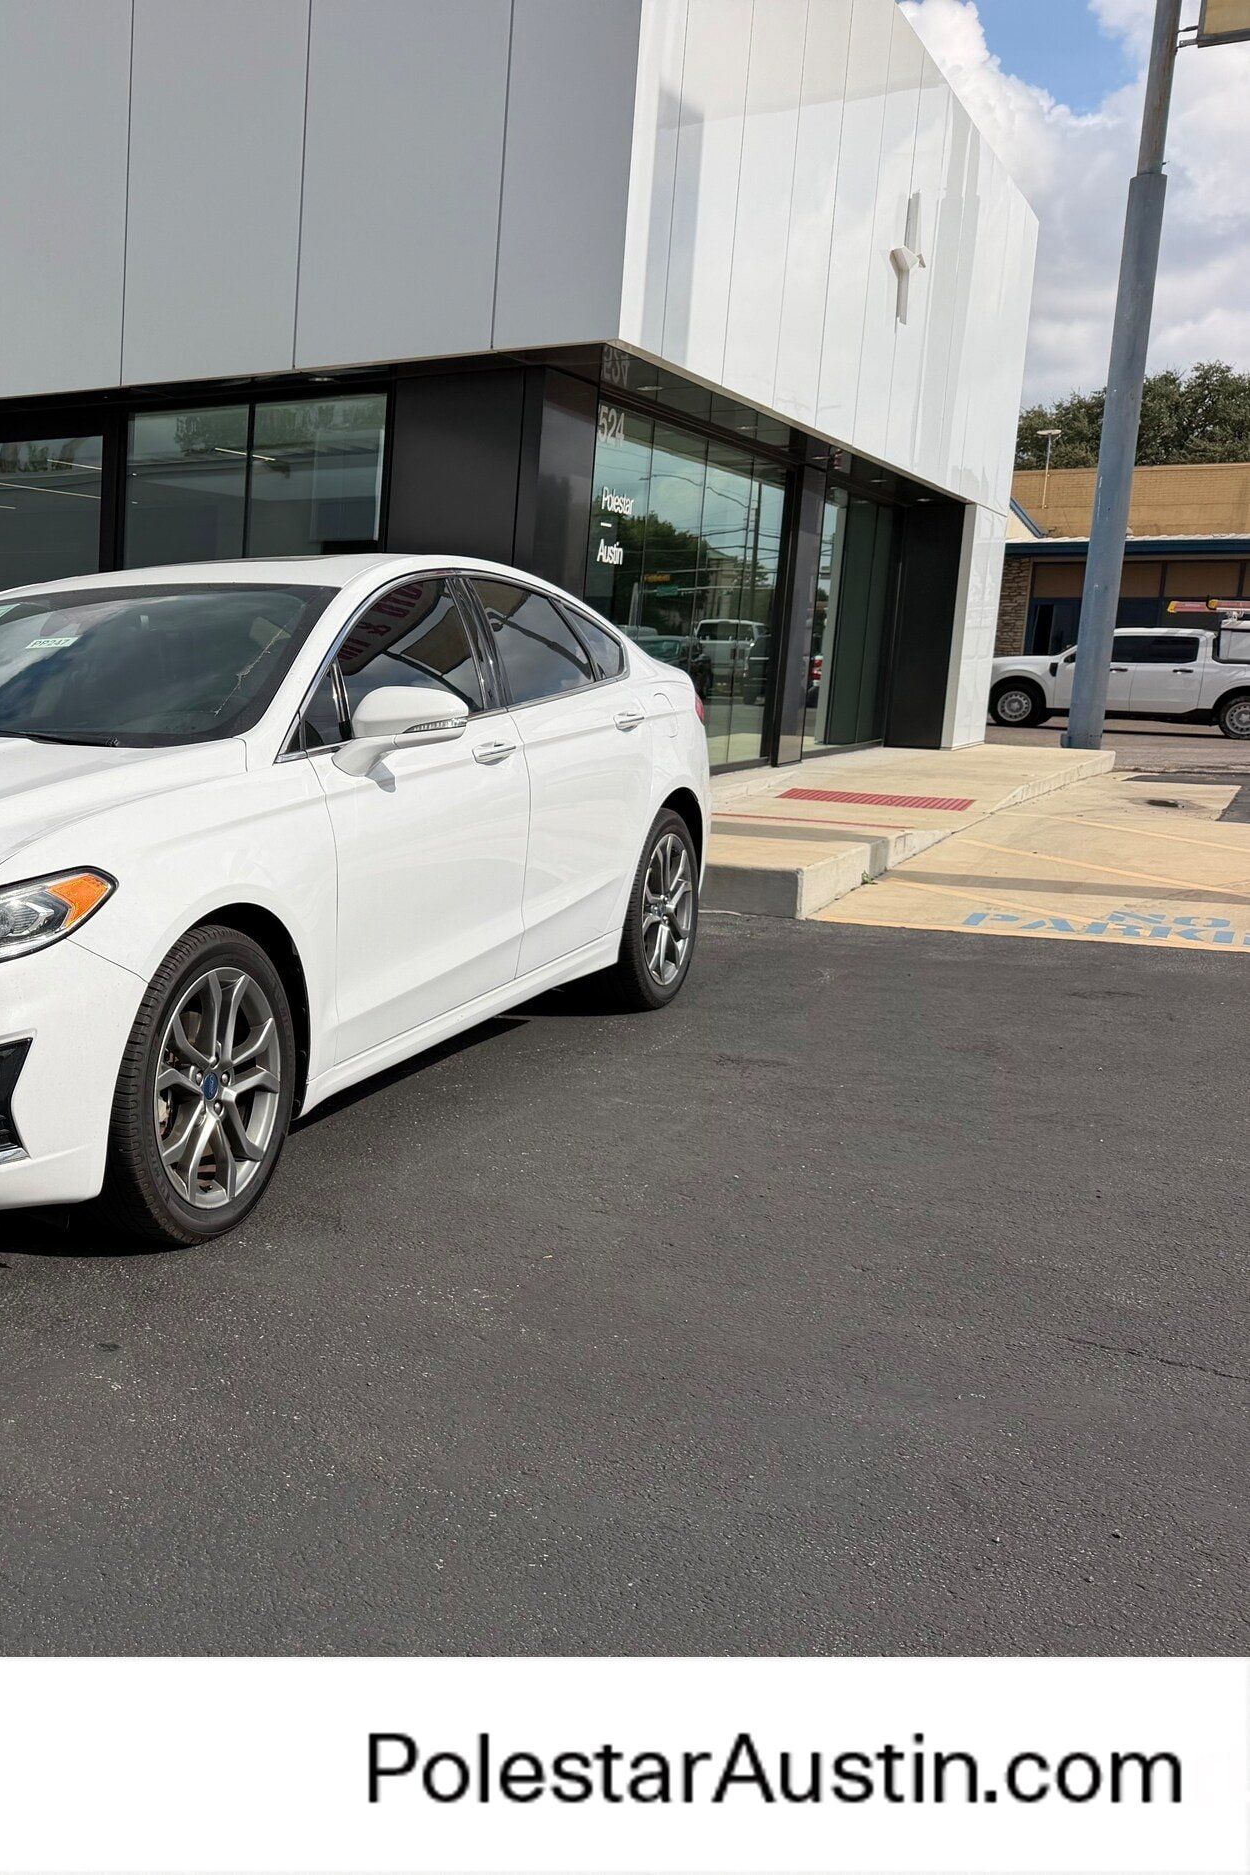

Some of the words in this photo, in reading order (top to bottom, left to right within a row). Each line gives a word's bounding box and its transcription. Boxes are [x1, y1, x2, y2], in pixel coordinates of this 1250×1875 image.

[597, 404, 625, 444] 524
[601, 486, 633, 515] Polestar
[597, 538, 623, 565] Austin
[962, 912, 1250, 947] PARKI
[1108, 911, 1231, 928] NO
